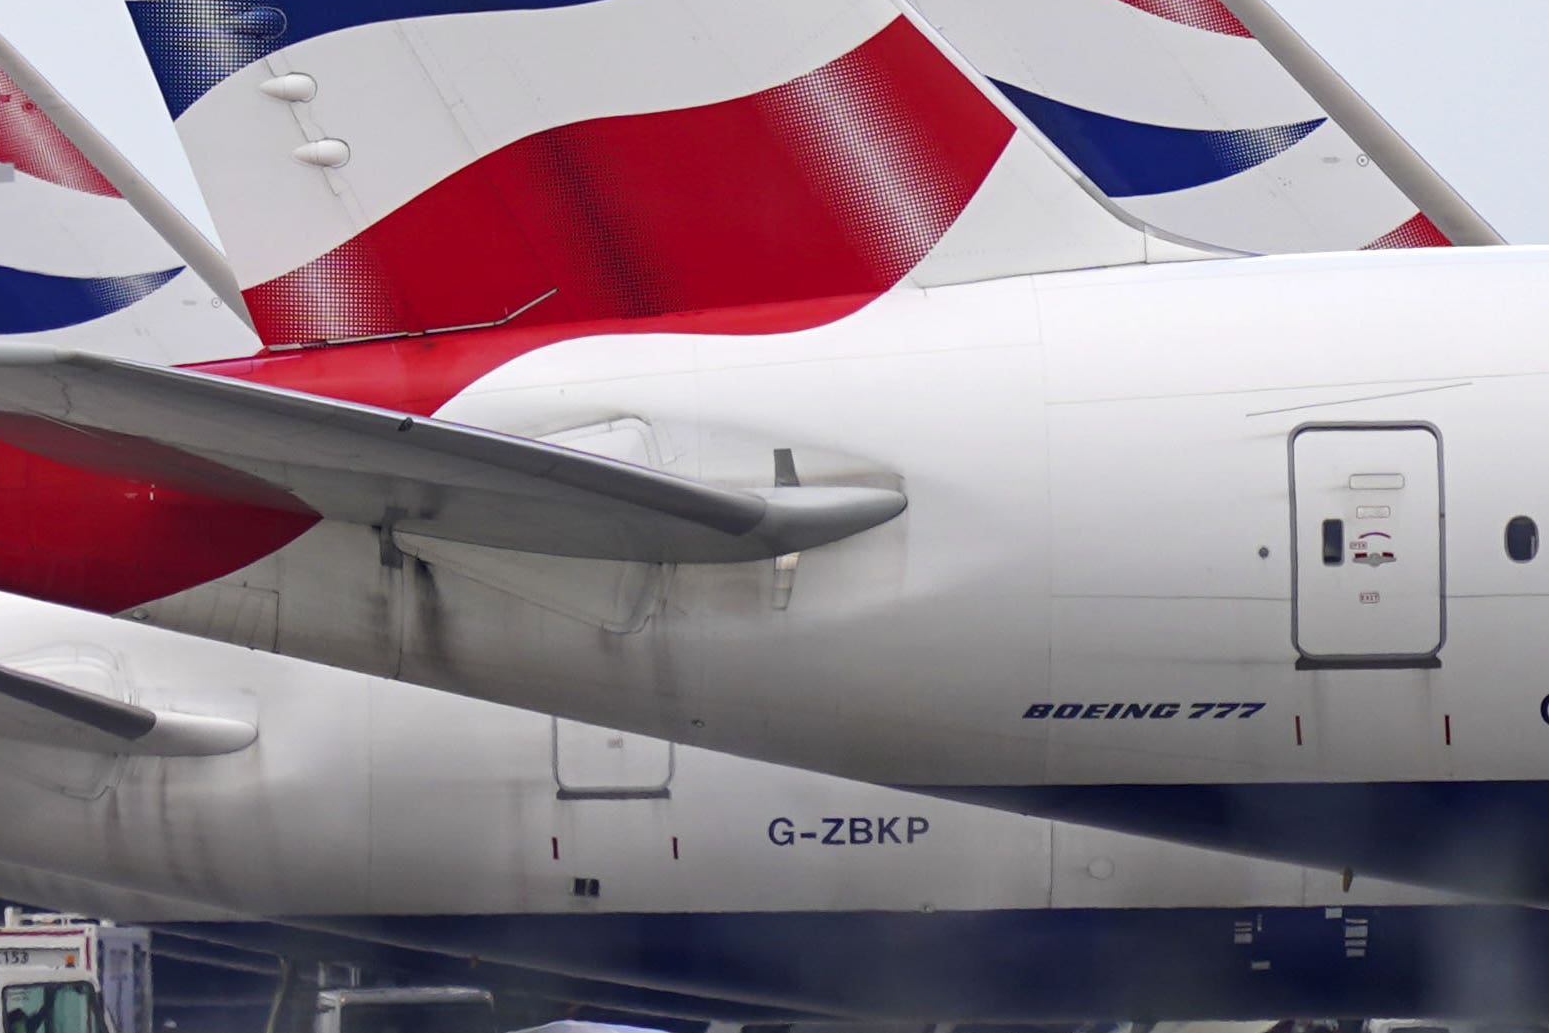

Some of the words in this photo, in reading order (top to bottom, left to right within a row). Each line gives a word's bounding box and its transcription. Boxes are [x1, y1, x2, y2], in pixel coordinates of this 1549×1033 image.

[1023, 704, 1180, 719] BOEING
[1188, 703, 1266, 718] 777
[769, 817, 928, 846] G-ZBKP
